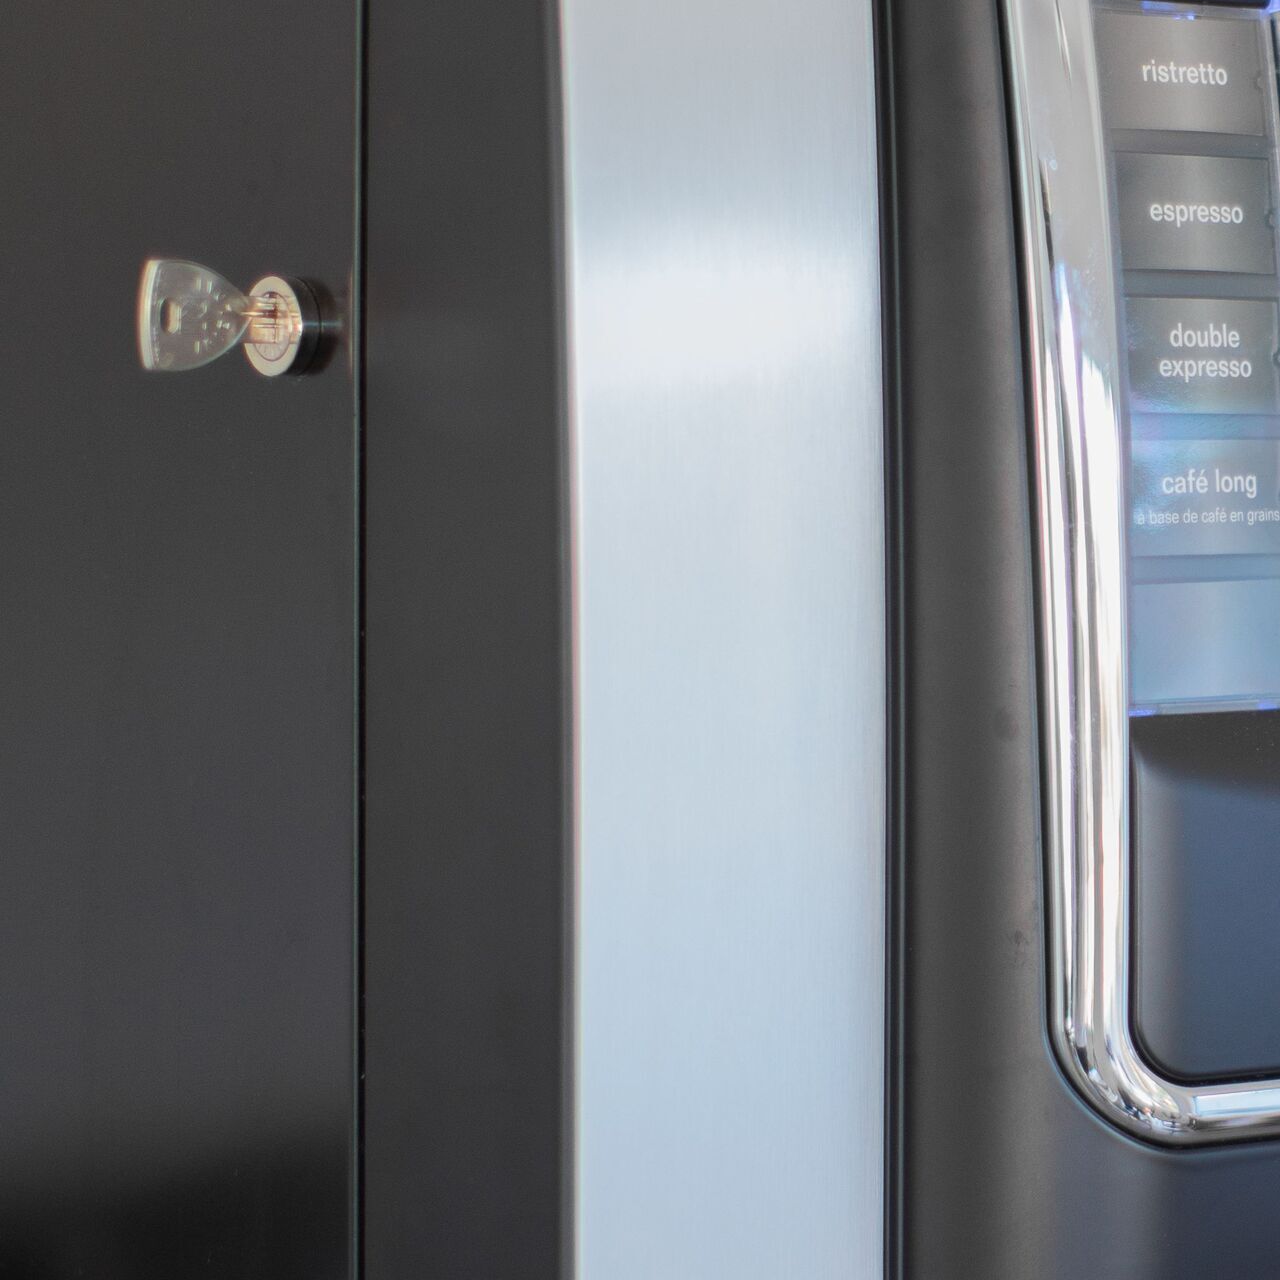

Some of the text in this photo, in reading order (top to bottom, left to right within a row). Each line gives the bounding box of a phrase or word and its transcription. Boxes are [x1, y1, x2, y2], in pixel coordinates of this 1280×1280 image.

[1142, 60, 1228, 86] ristretto
[1150, 203, 1243, 228] espresso
[1170, 323, 1240, 348] double
[1159, 357, 1252, 382] expresso
[1162, 469, 1257, 498] café long
[1149, 508, 1179, 524] base
[1183, 506, 1199, 523] de
[1201, 506, 1227, 522] café
[1230, 510, 1244, 522] en
[1247, 507, 1280, 525] grains
